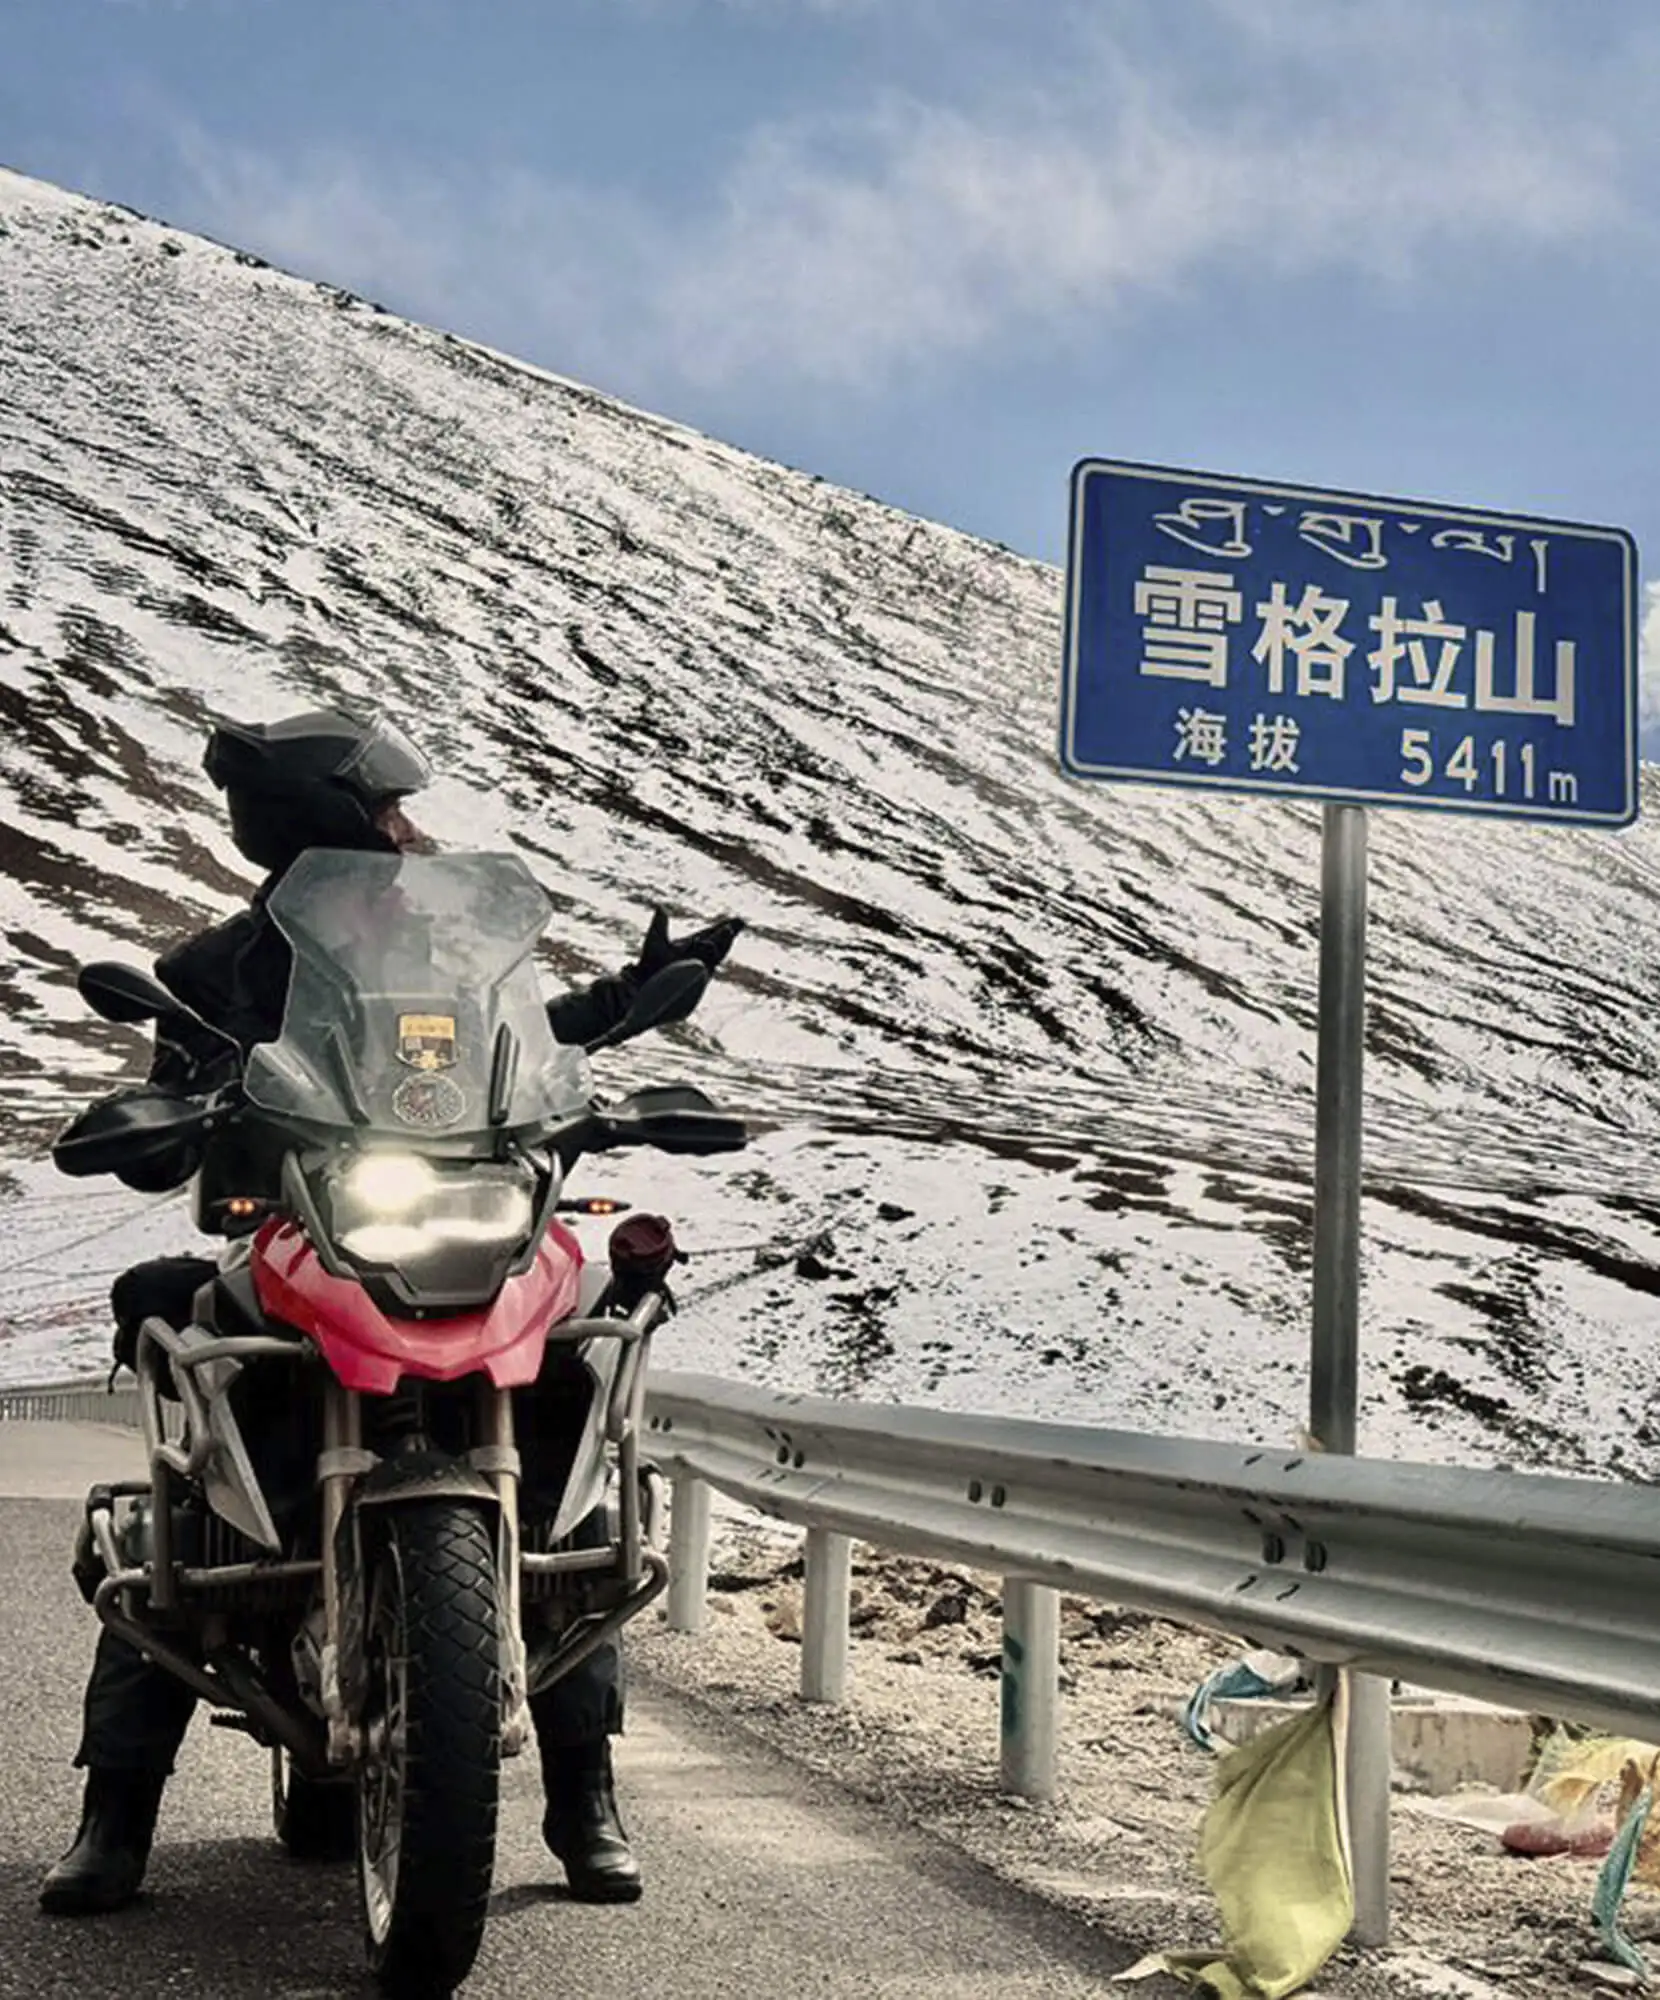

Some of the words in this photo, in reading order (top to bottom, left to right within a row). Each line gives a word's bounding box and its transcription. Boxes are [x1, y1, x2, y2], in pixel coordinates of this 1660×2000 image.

[1134, 565, 1575, 727] 雪格拉山
[1173, 707, 1300, 773] 海拔
